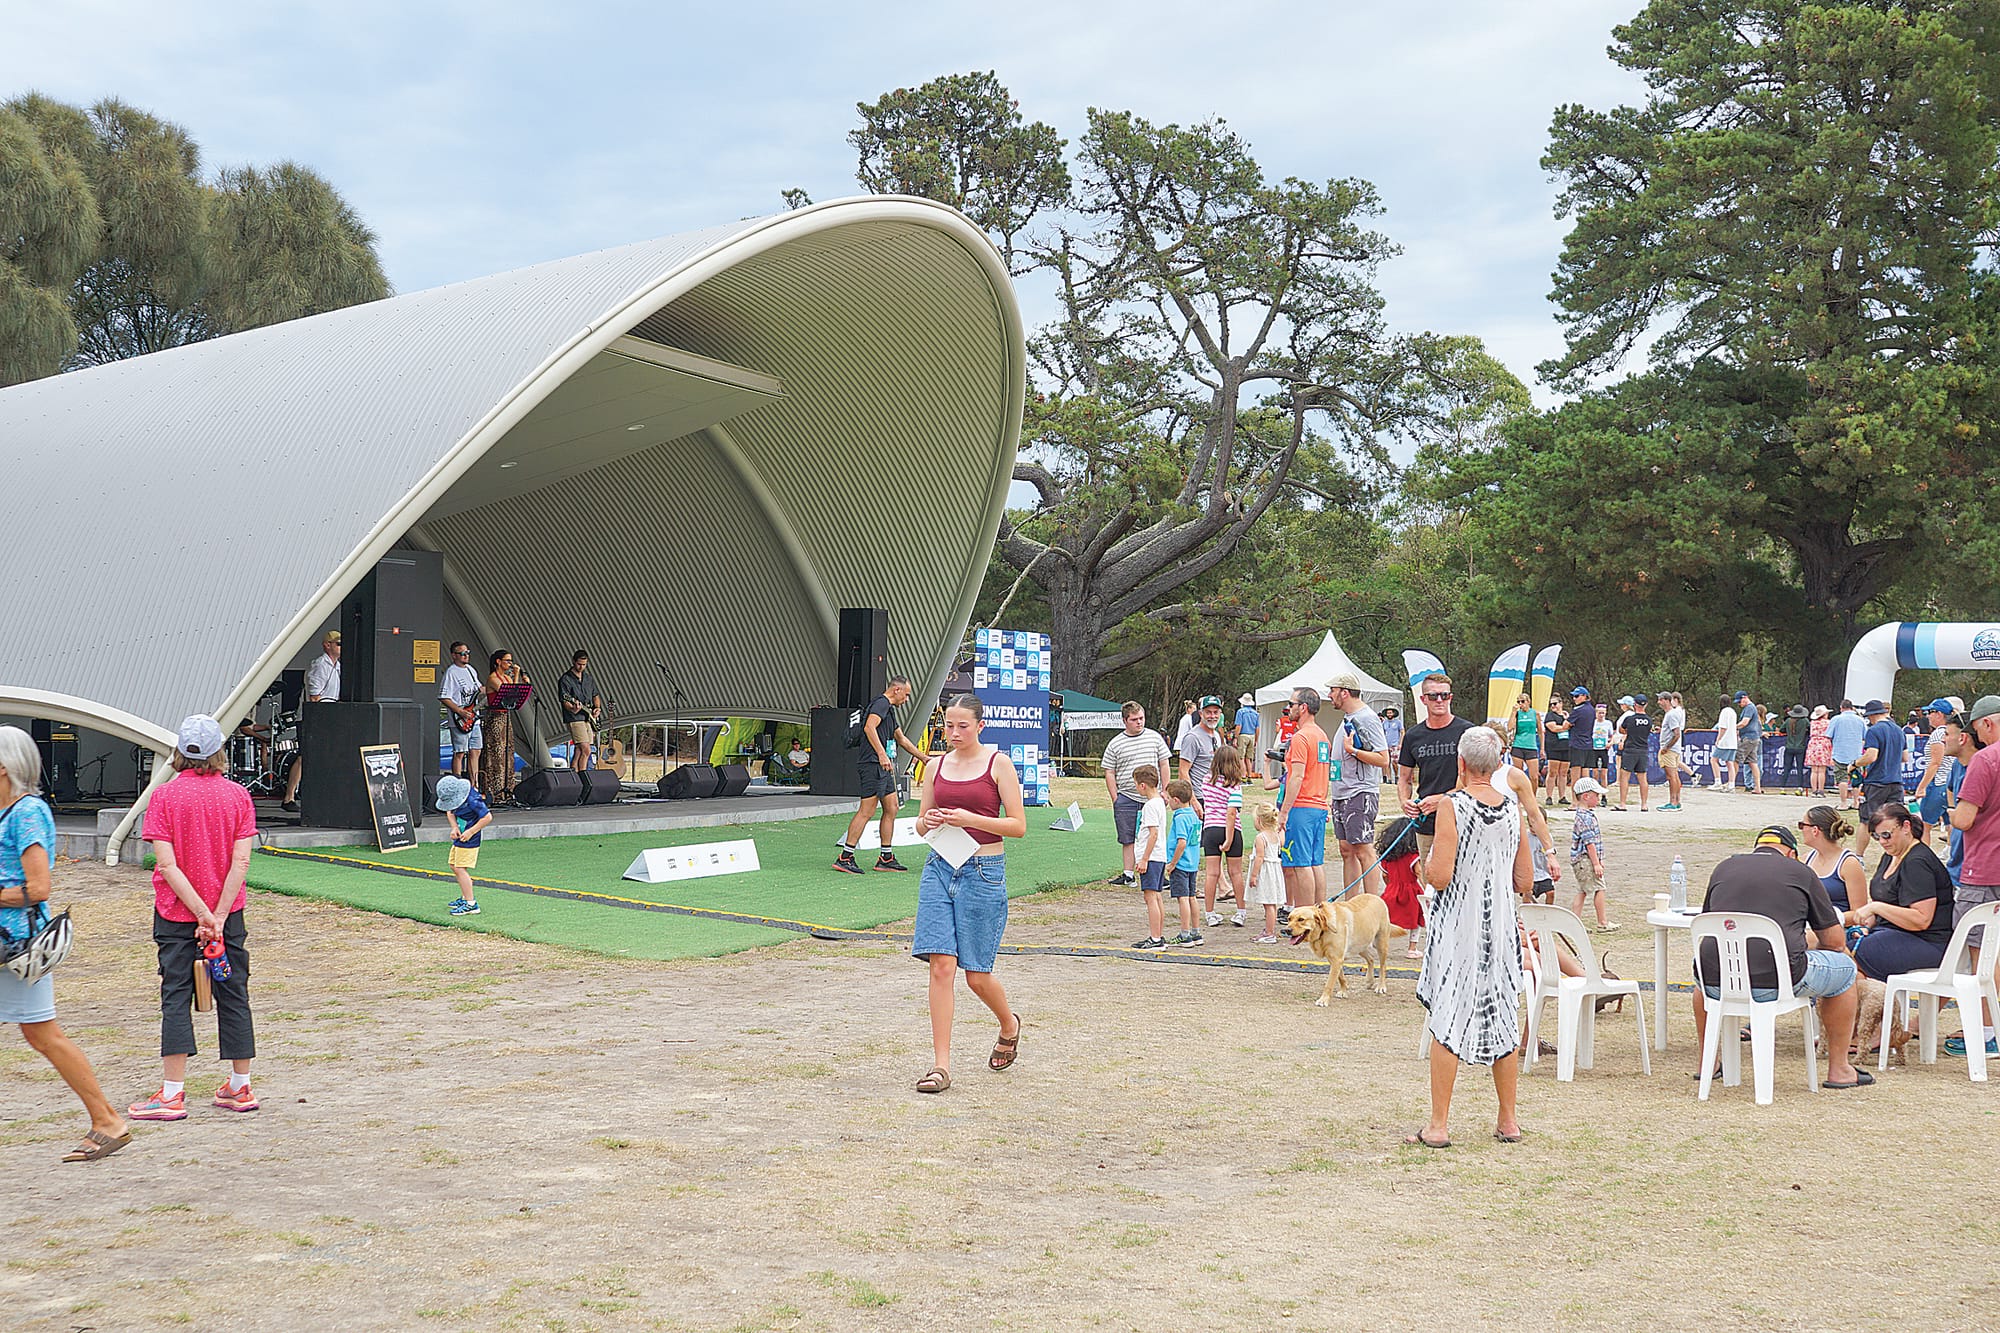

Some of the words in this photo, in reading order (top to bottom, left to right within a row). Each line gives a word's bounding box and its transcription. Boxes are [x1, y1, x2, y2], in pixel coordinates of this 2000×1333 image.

[982, 705, 1042, 719] INVERLOCH
[984, 719, 1011, 728] UNNING
[1011, 720, 1042, 729] FESTIVAL
[1417, 740, 1456, 758] saint
